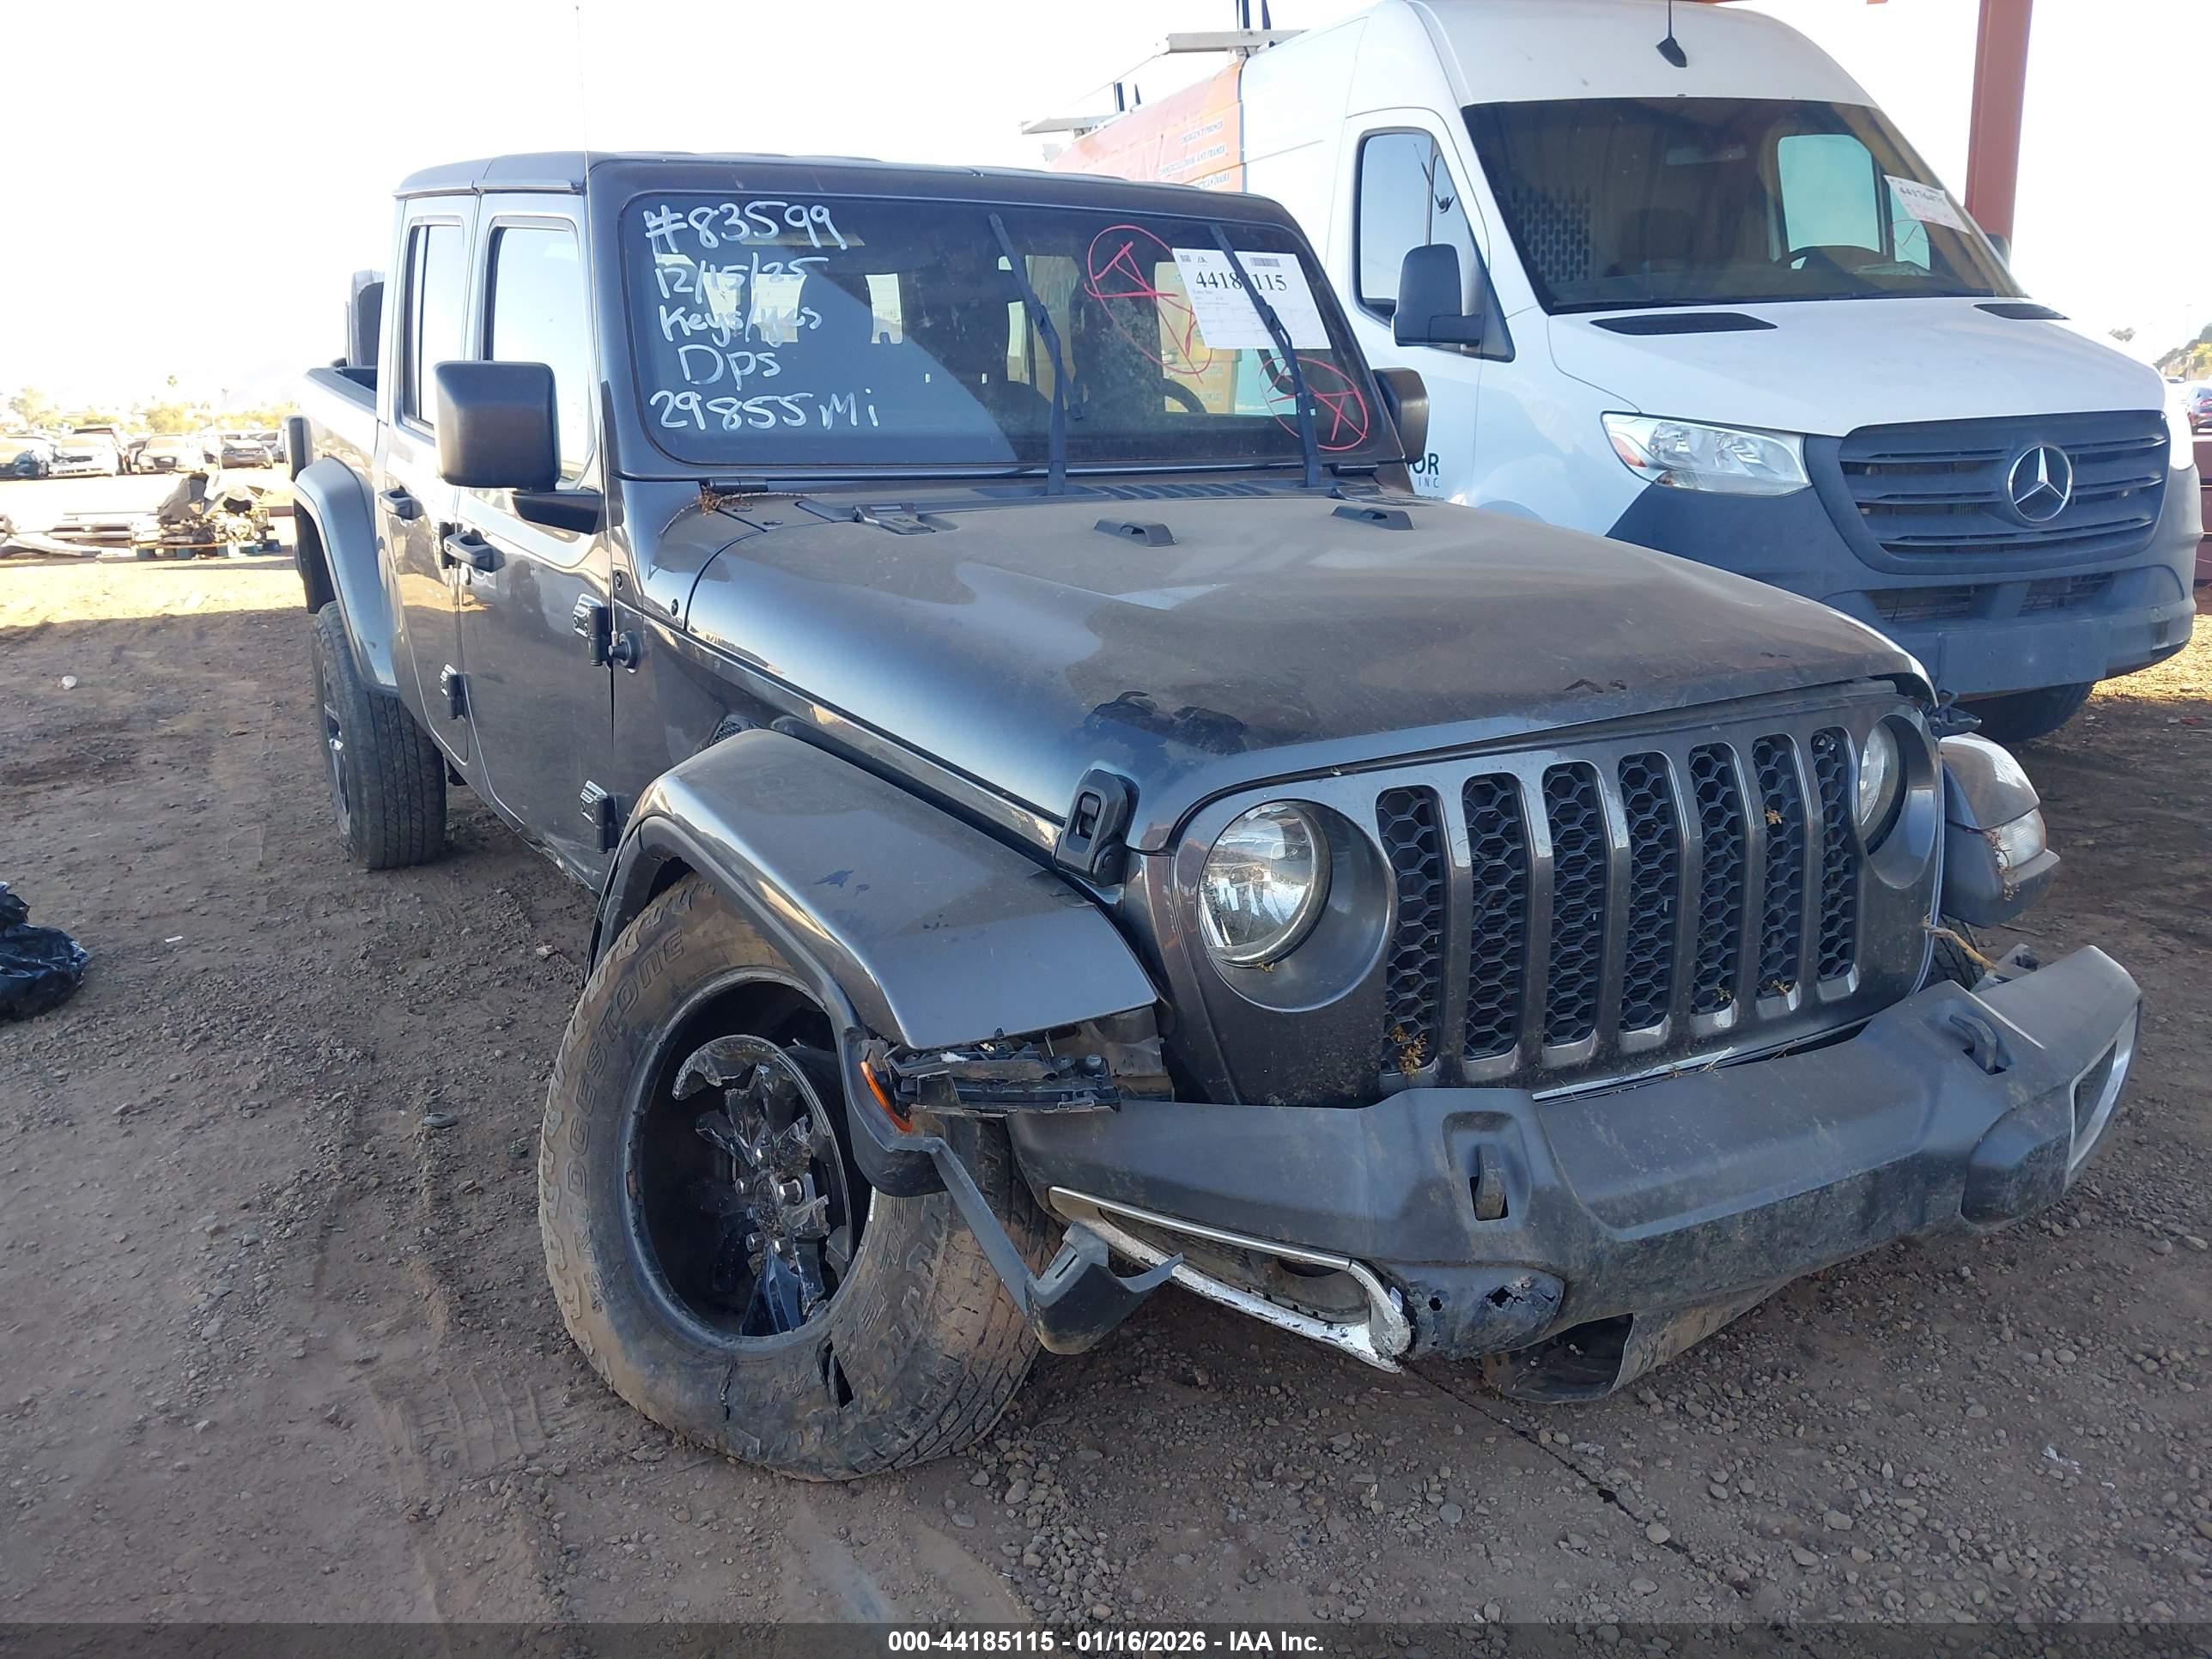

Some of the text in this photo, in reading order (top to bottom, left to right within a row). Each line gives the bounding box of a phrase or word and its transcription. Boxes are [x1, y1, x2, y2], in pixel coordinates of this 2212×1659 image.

[644, 200, 848, 256] #83599
[654, 252, 830, 304] 12/15/25
[1196, 270, 1287, 292] 4418115
[650, 388, 878, 429] 29855 Mi
[1419, 477, 1439, 488] INC
